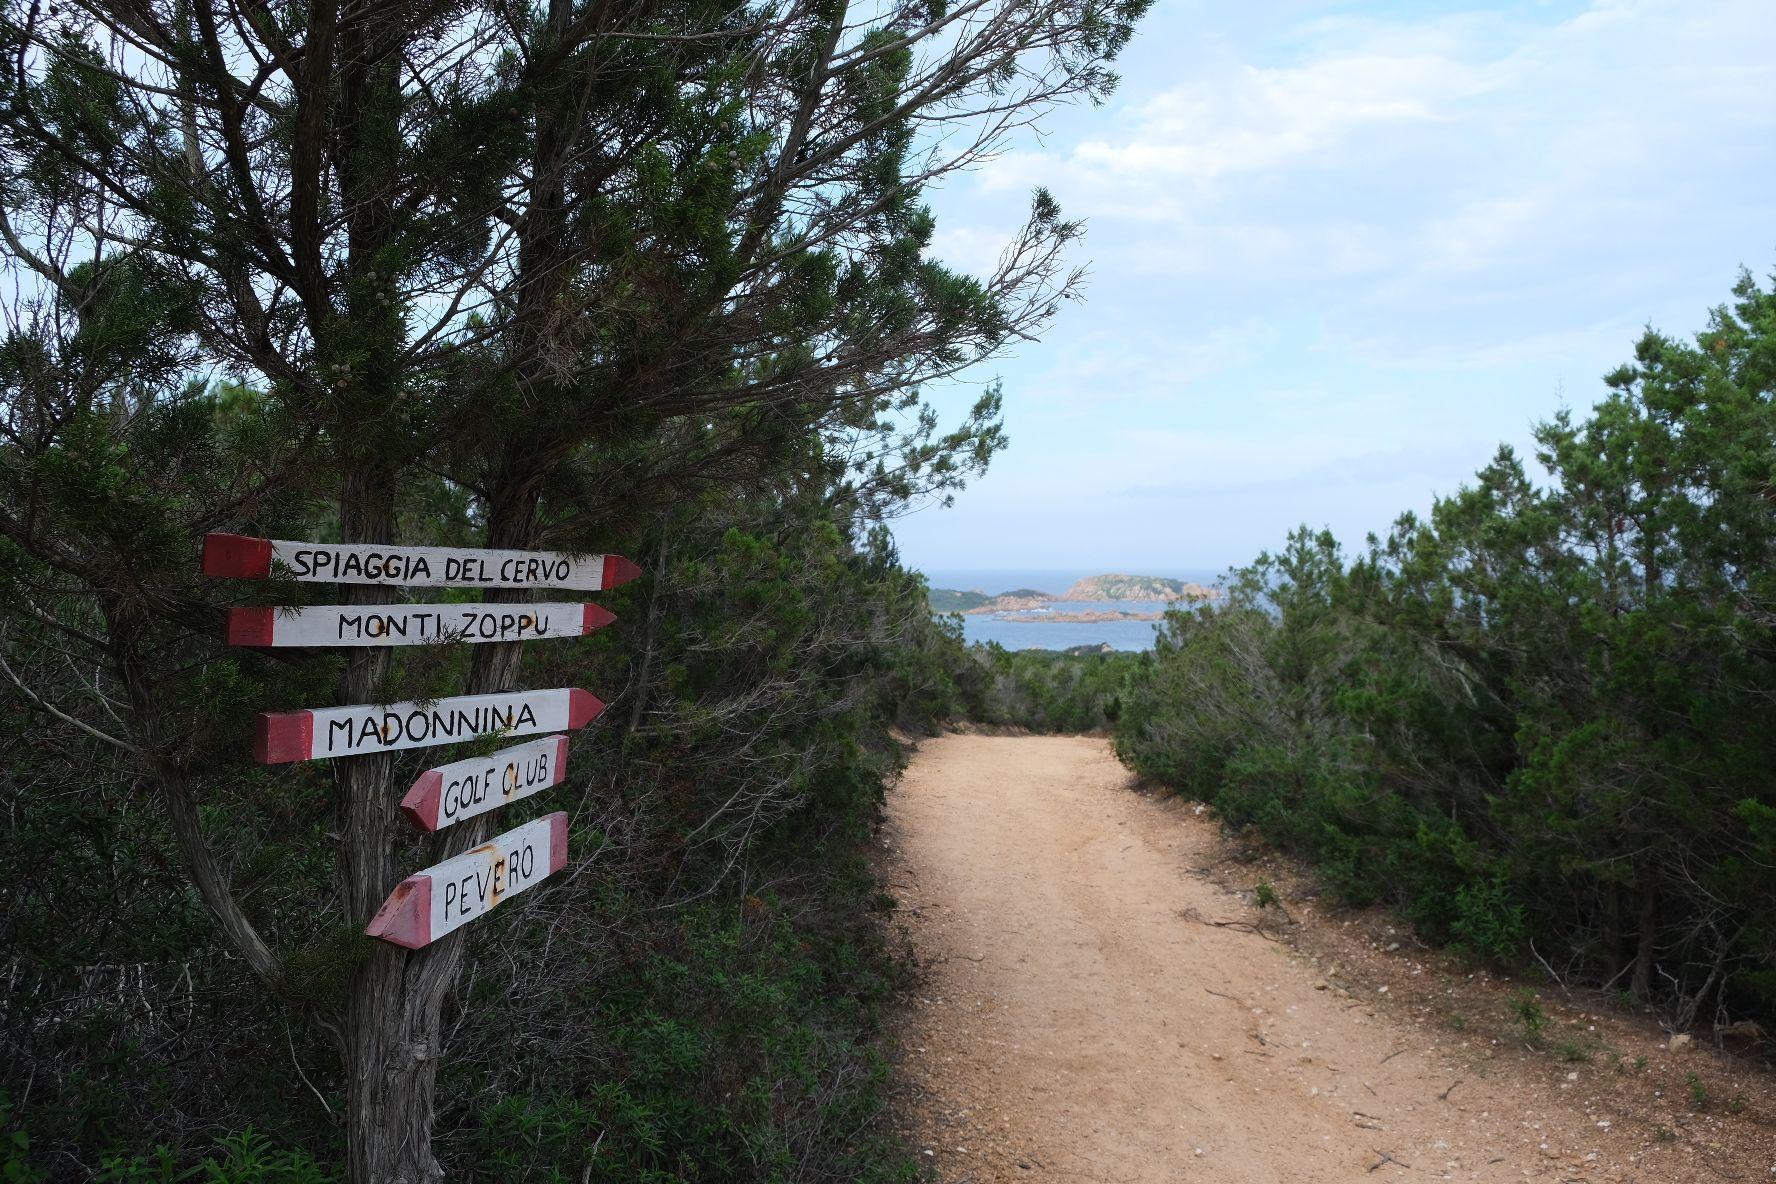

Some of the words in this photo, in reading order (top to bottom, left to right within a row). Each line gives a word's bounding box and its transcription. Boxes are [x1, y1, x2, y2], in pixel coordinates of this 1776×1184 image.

[294, 550, 431, 580] SPIAGGIA
[445, 557, 494, 581] DEL
[500, 558, 570, 582] CERVO
[338, 613, 441, 639] MONTI
[460, 613, 548, 639] ZOPPU
[328, 703, 537, 751] MADONNINA
[444, 768, 496, 818] GOLF
[502, 754, 548, 796] CLUB
